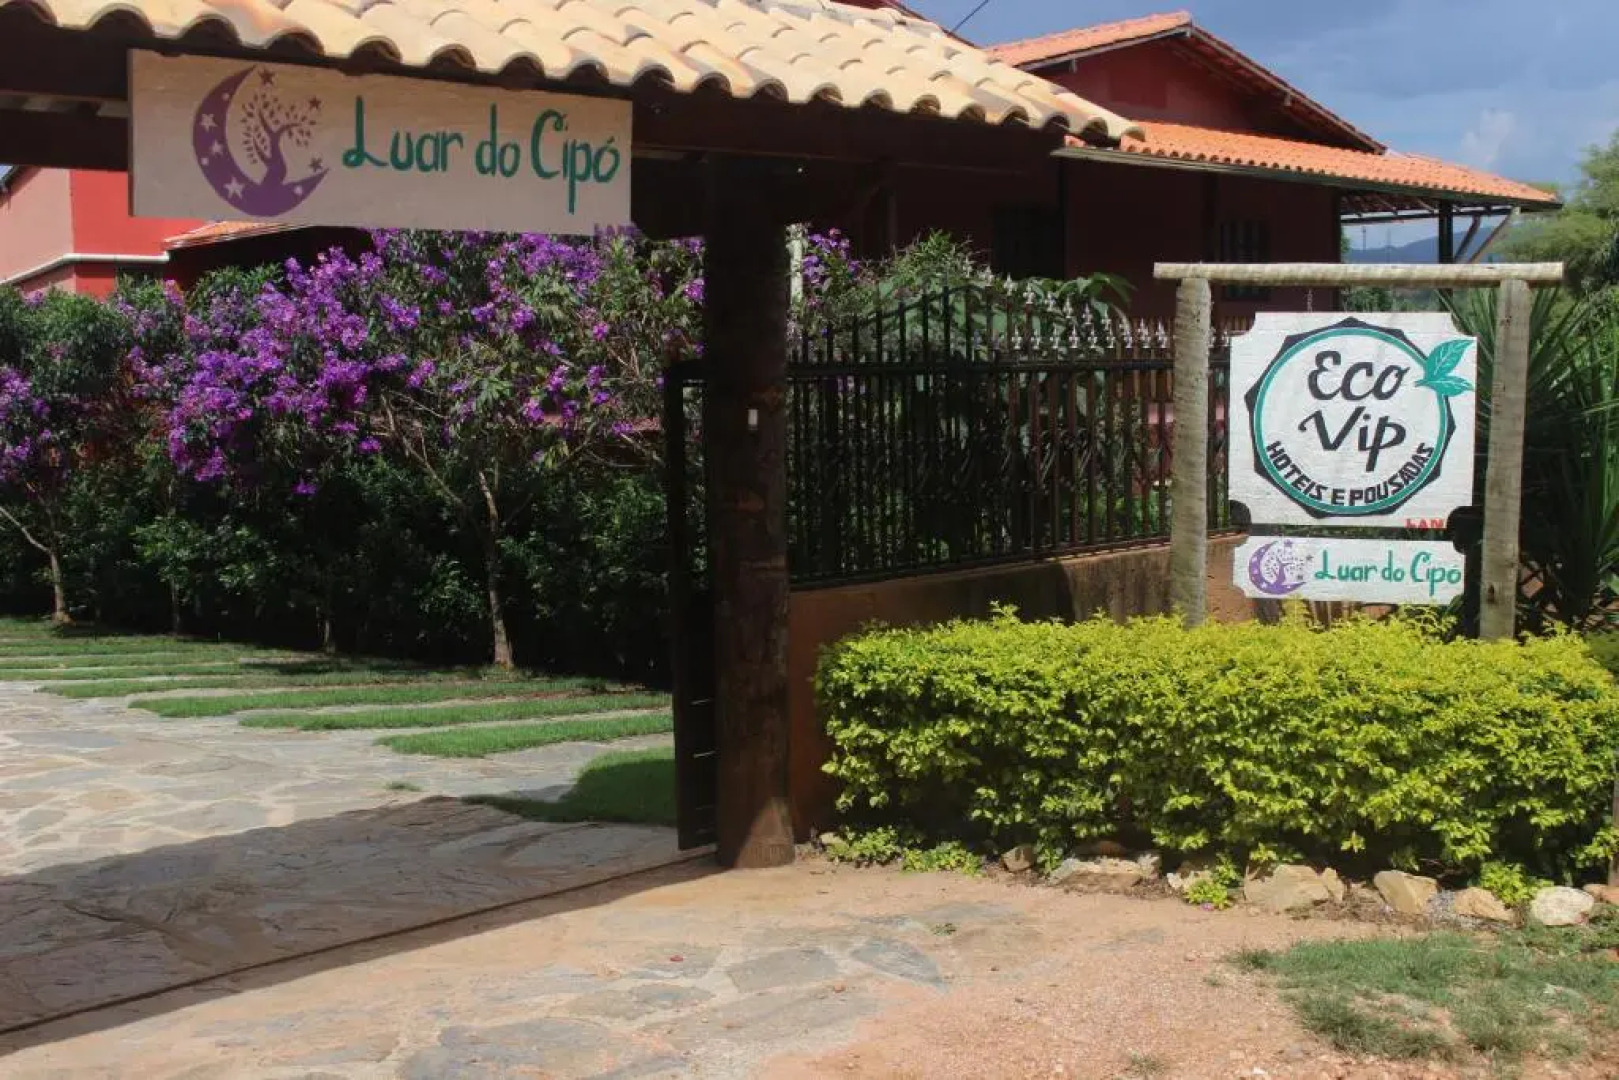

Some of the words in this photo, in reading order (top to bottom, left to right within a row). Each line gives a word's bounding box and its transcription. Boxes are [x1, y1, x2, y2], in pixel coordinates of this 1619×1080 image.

[342, 95, 464, 172] Luar
[475, 102, 521, 178] do
[530, 108, 620, 214] Cipó
[1307, 350, 1411, 401] Eco
[1297, 405, 1407, 473] Vip
[1265, 440, 1329, 501] HOTEIS
[1330, 488, 1345, 506] E
[1348, 442, 1435, 507] POUSADAS
[1314, 550, 1378, 583] Luar
[1381, 550, 1405, 582] do
[1410, 550, 1462, 597] Cipó
